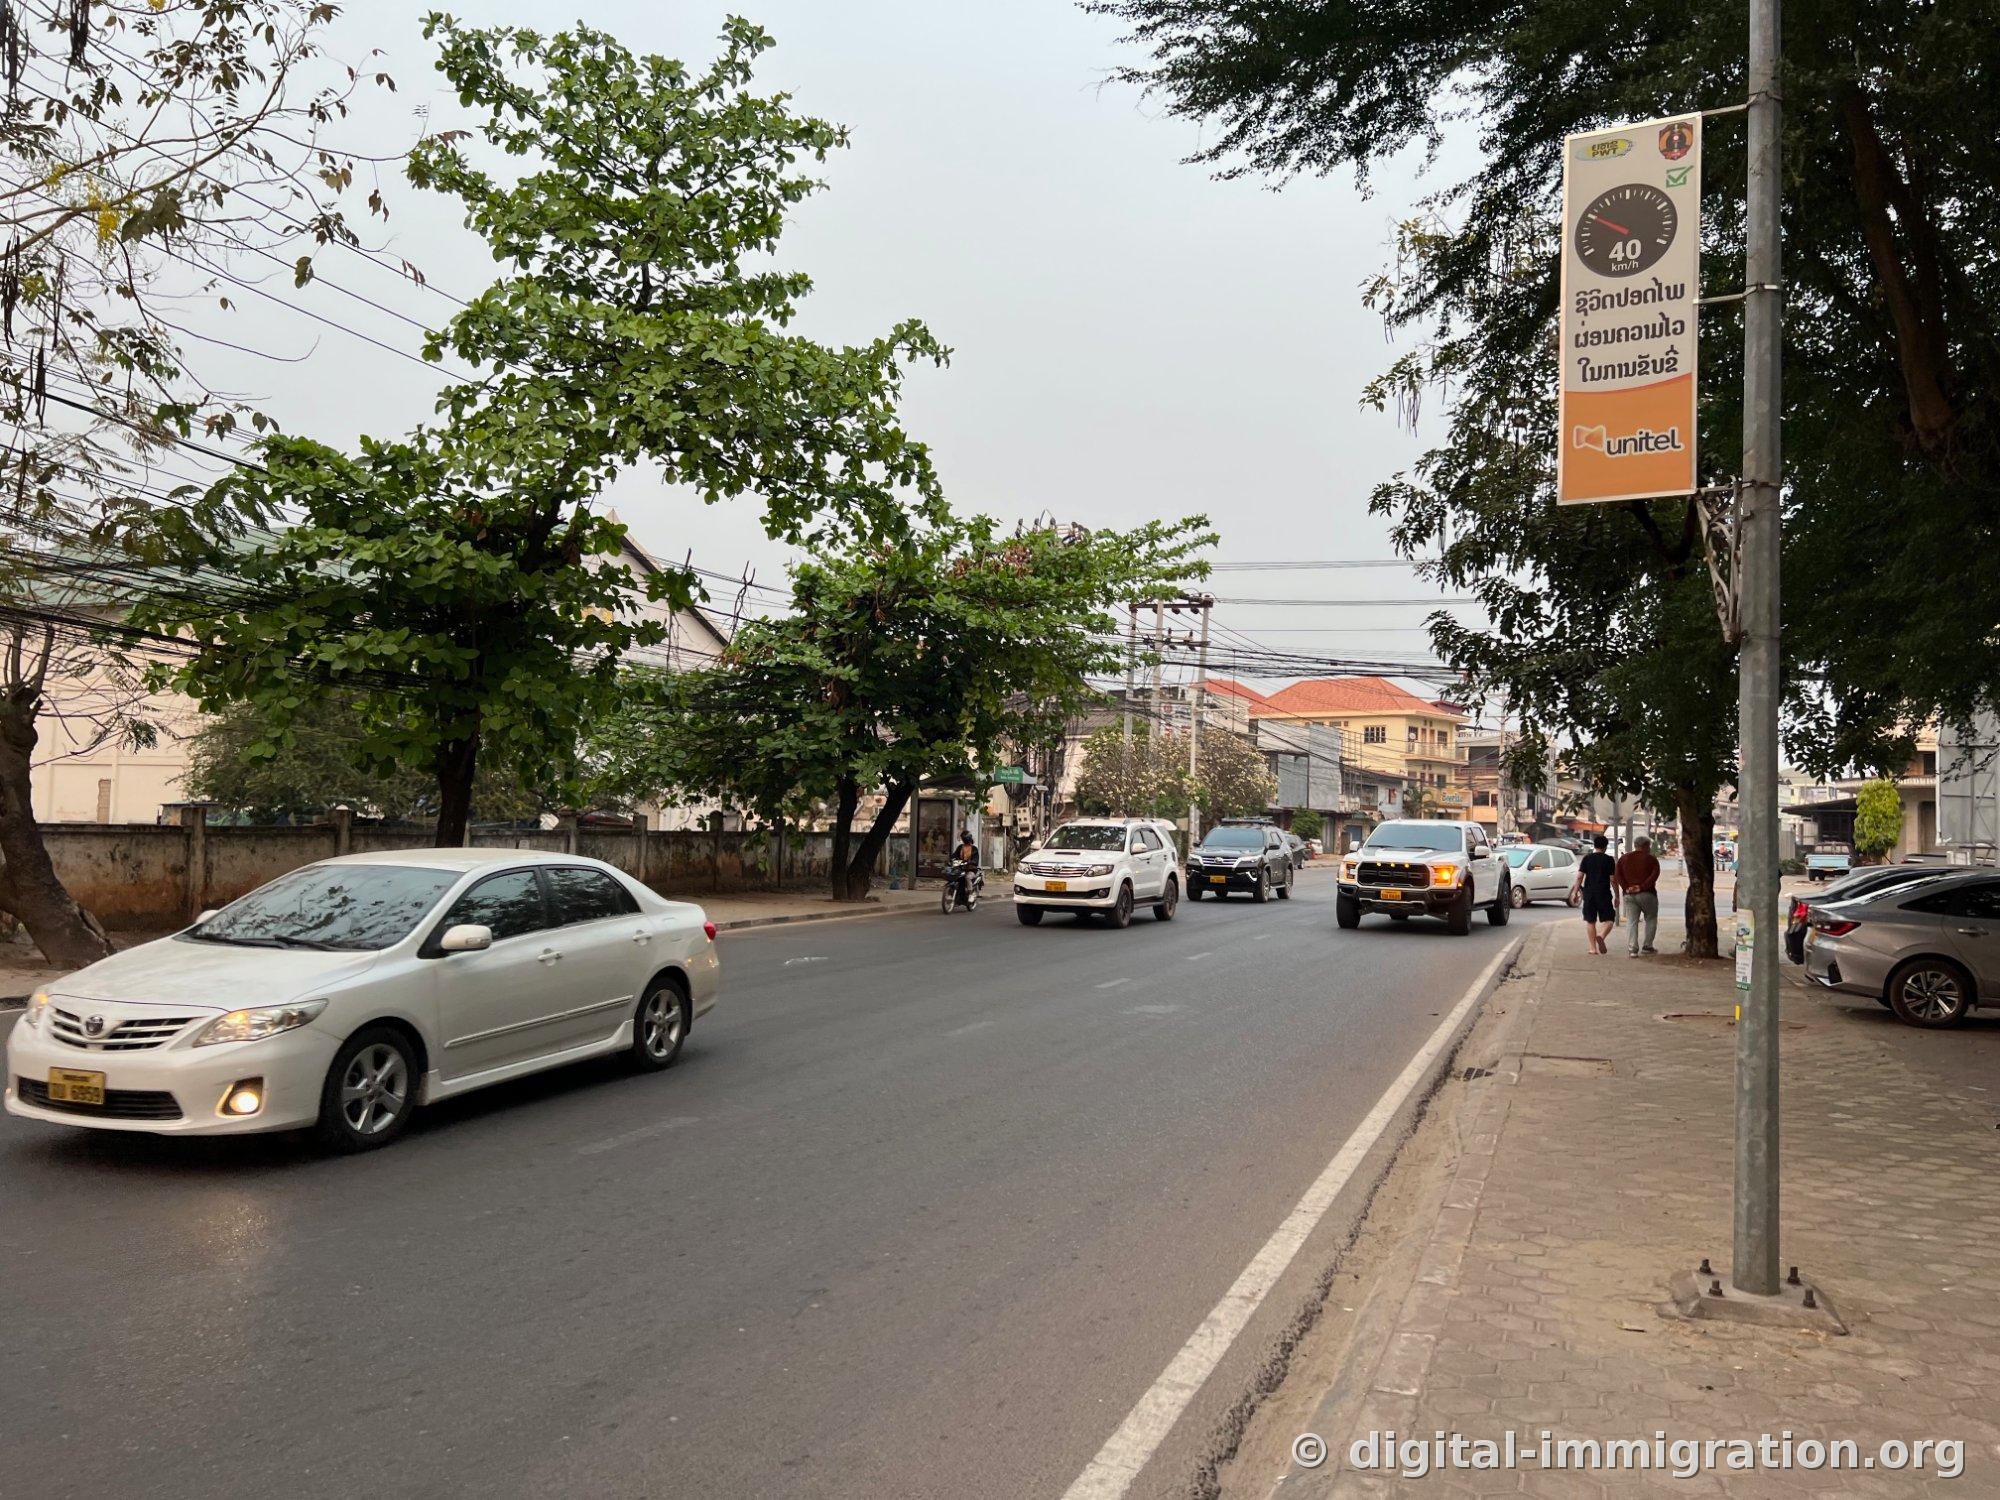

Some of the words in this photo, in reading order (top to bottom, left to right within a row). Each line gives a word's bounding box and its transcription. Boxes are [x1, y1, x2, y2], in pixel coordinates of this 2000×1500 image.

[1591, 148, 1618, 157] PWT
[1608, 238, 1642, 262] 40
[1611, 260, 1639, 272] km/h
[1606, 428, 1682, 457] unitel
